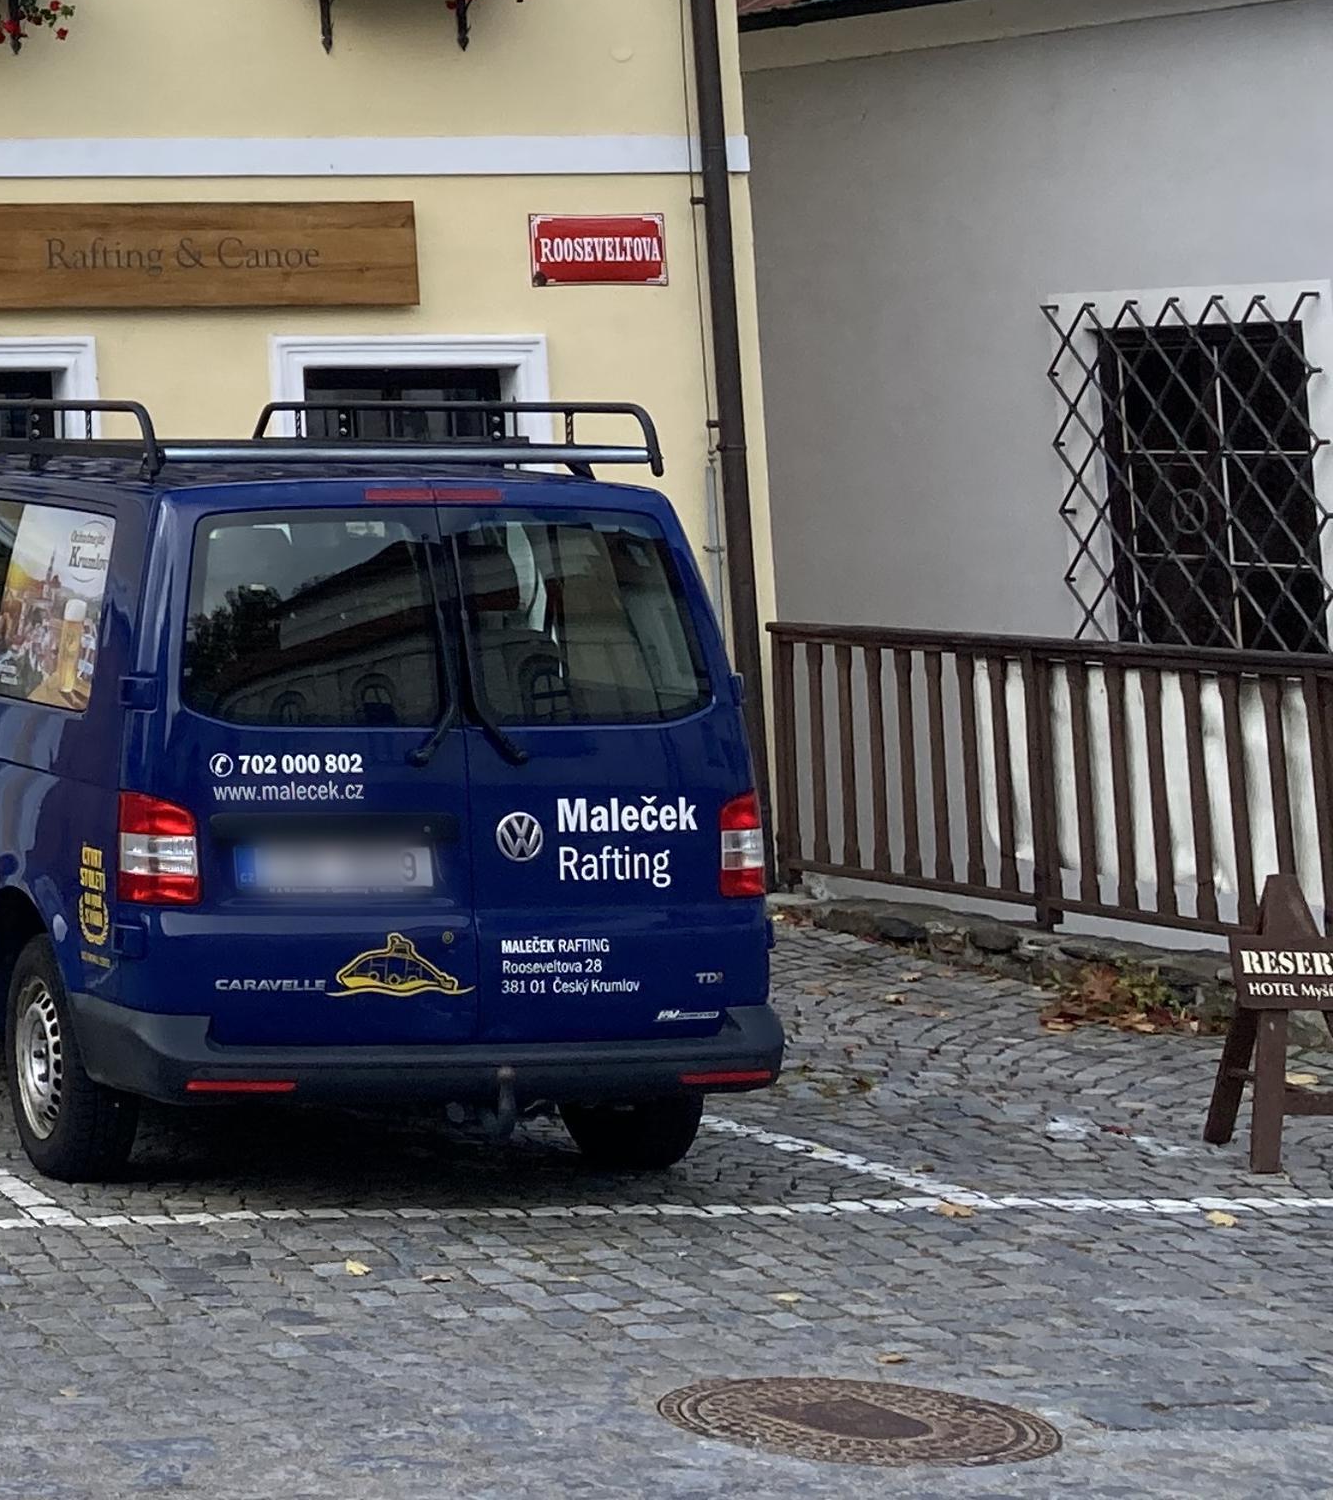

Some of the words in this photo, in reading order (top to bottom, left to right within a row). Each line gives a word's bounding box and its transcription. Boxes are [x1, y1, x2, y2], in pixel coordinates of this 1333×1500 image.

[45, 237, 164, 277] Rafting
[176, 237, 206, 269] &
[217, 237, 321, 270] Canoe
[539, 237, 662, 263] ROOSEVELTOVA
[238, 754, 277, 775] 702
[281, 754, 321, 774] 000
[325, 753, 364, 774] 802
[213, 780, 364, 801] www.malecek.cz
[557, 795, 698, 833] Maleček
[558, 845, 672, 888] Rafting
[501, 936, 555, 954] MALEČEK
[558, 938, 610, 953] RAFTING
[502, 959, 583, 974] Rooseveltova
[584, 958, 603, 973] 28
[1239, 950, 1333, 976] RESER
[215, 979, 326, 991] CARAVELLE
[501, 980, 526, 994] 381
[530, 980, 546, 994] 01
[553, 976, 590, 996] Český
[591, 978, 640, 993] Krumlov
[1247, 982, 1299, 997] HOTEL
